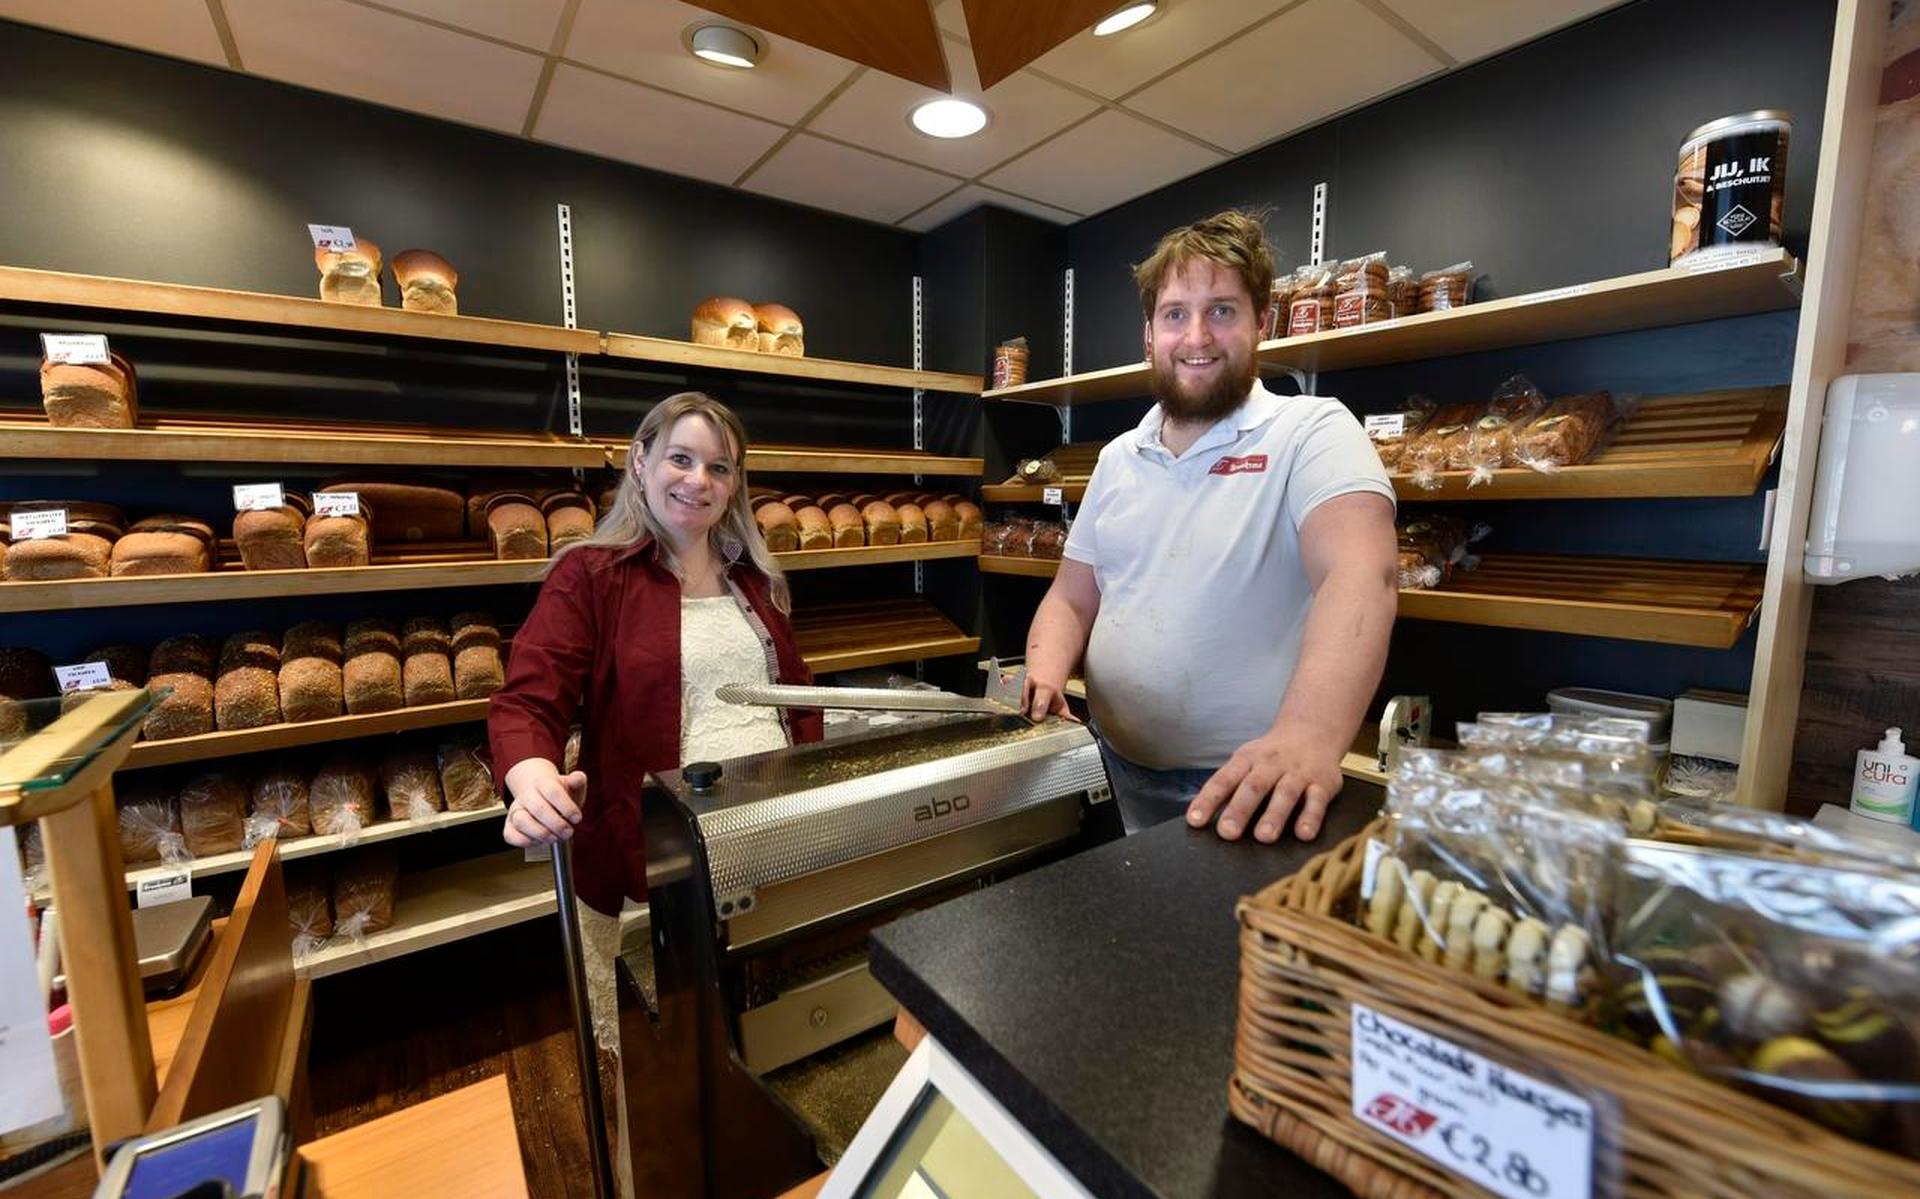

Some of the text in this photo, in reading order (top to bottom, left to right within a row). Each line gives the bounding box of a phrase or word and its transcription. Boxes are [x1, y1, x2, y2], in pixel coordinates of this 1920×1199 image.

[1749, 157, 1771, 173] IK
[1863, 759, 1891, 773] uni
[1862, 769, 1907, 785] cura
[913, 795, 970, 821] abo
